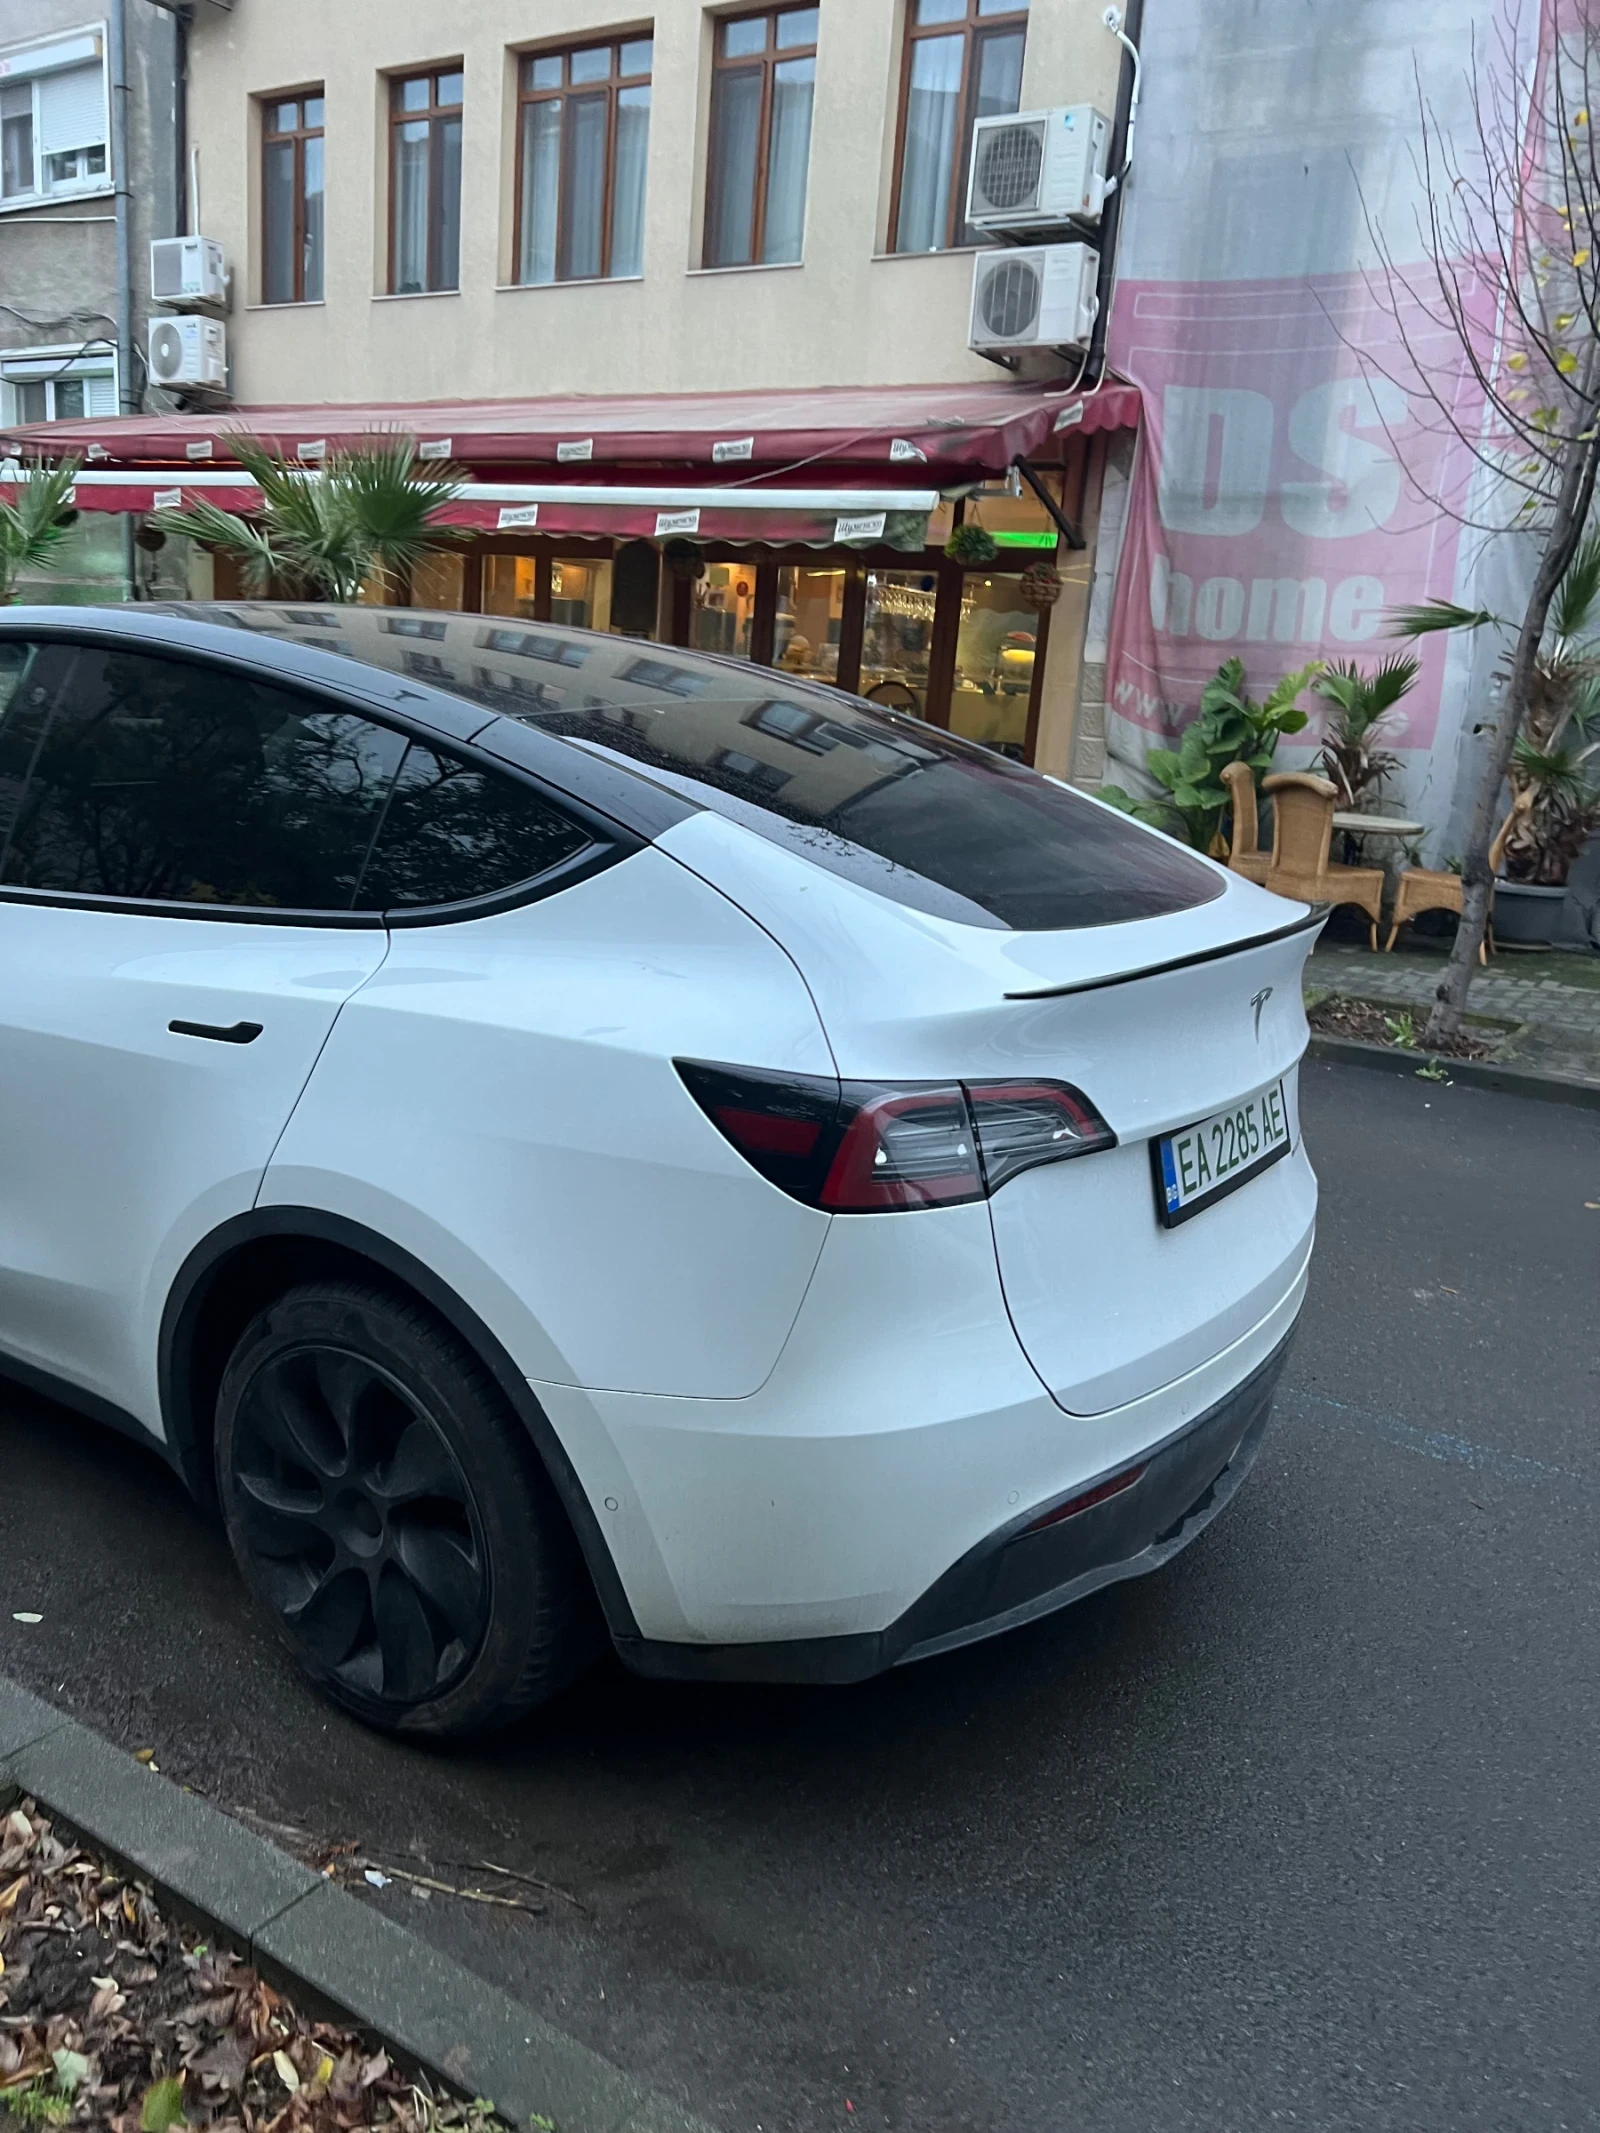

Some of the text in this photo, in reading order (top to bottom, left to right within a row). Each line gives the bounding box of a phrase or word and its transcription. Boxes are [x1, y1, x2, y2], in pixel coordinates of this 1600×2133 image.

[1158, 377, 1408, 539] DS
[1151, 553, 1381, 642] home
[1178, 1132, 1212, 1196] EA
[1212, 1104, 1259, 1178] 2285
[1262, 1089, 1284, 1147] AE
